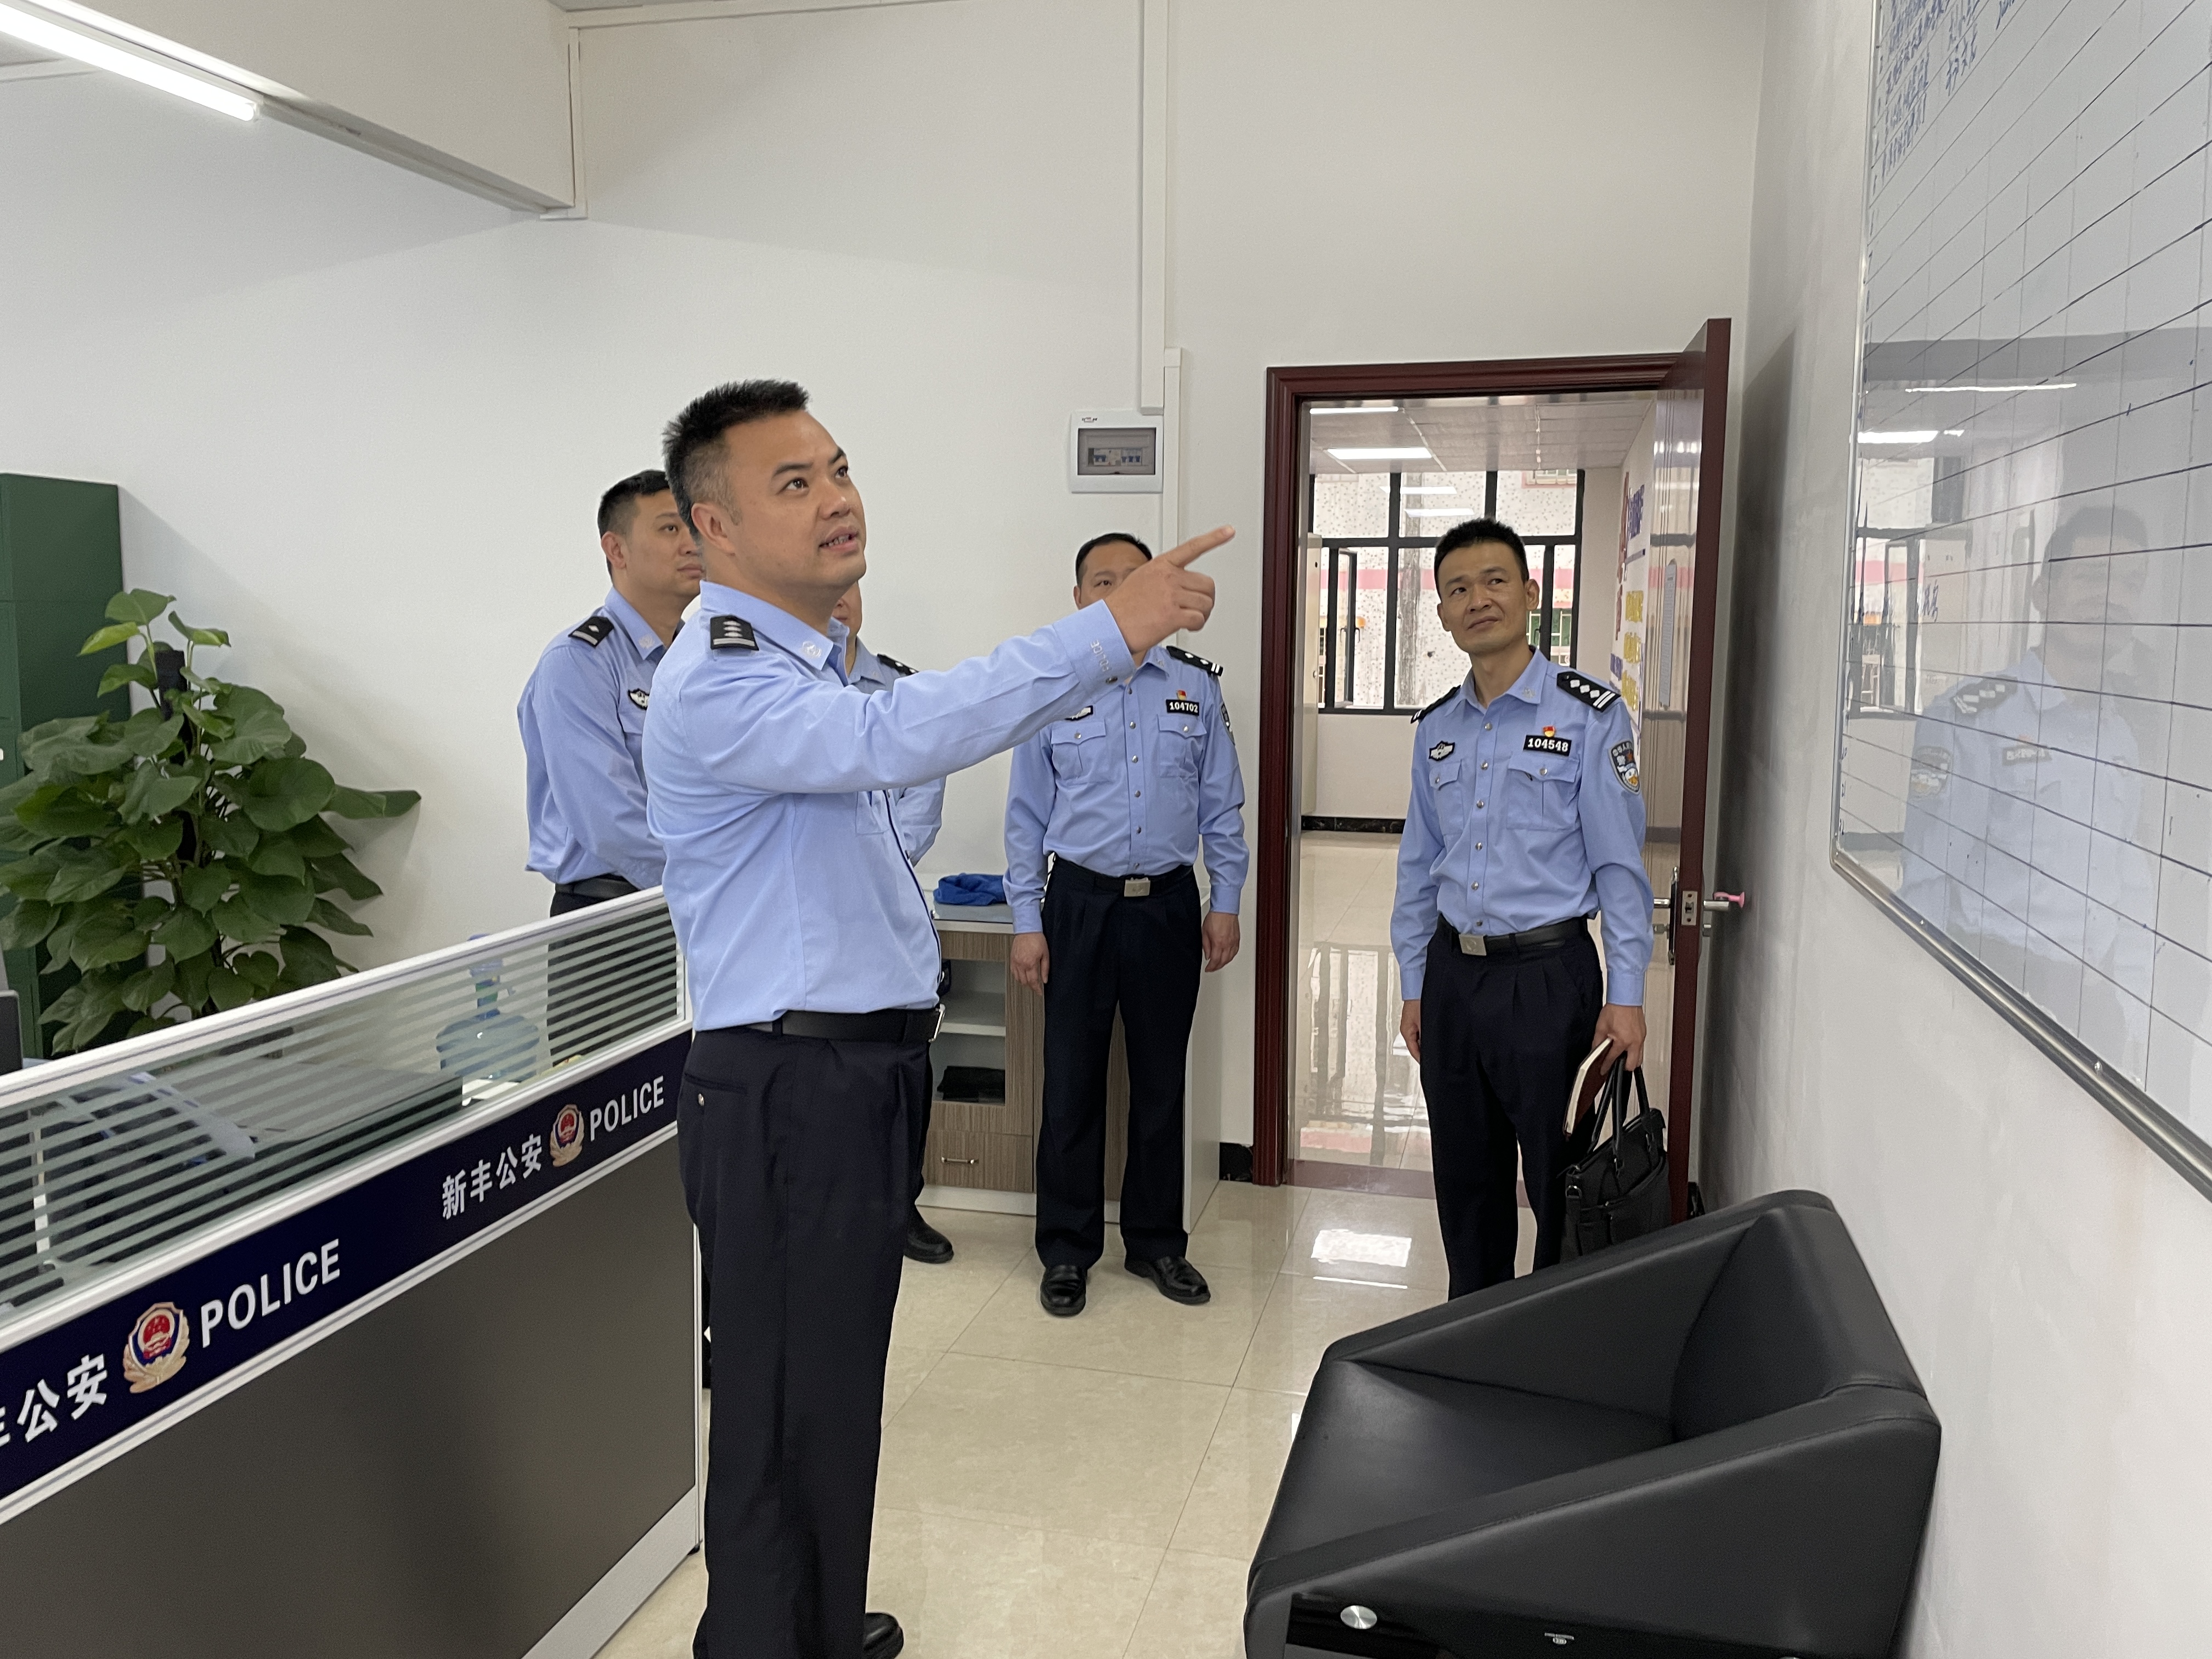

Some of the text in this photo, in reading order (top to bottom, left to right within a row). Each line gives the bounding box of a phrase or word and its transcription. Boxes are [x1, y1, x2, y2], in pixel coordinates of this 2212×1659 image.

[1090, 640, 1109, 672] POLICE
[1169, 701, 1199, 713] 104702
[1527, 737, 1569, 753] 104548
[442, 1075, 664, 1220] 新丰公安 POLICE
[200, 1238, 340, 1348] POLICE
